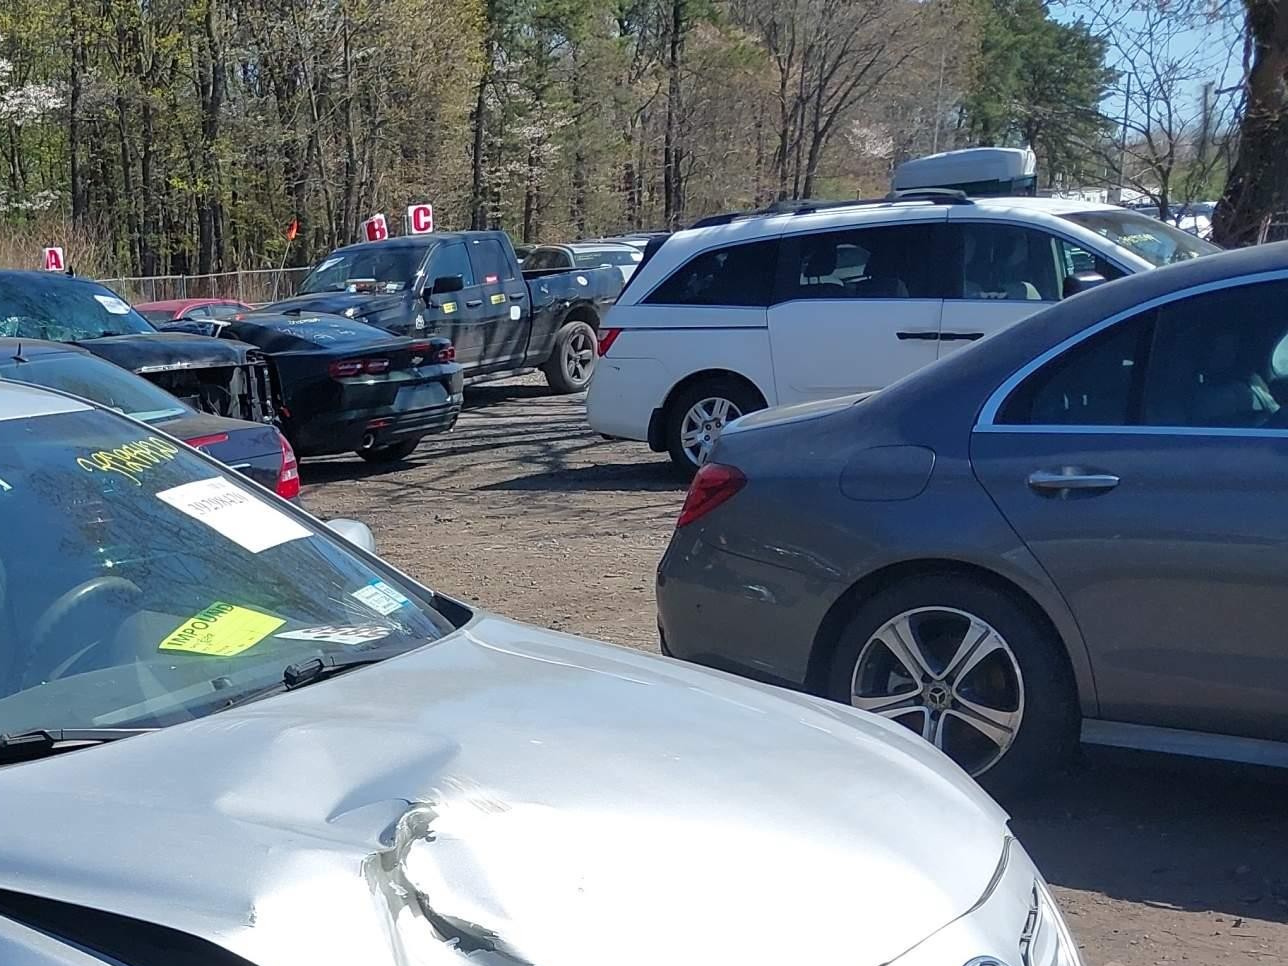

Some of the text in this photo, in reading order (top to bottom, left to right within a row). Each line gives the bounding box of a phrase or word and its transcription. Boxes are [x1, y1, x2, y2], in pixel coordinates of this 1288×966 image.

[367, 218, 386, 241] B
[413, 206, 431, 231] C
[45, 249, 62, 270] A
[167, 602, 234, 647] IMPOUND
